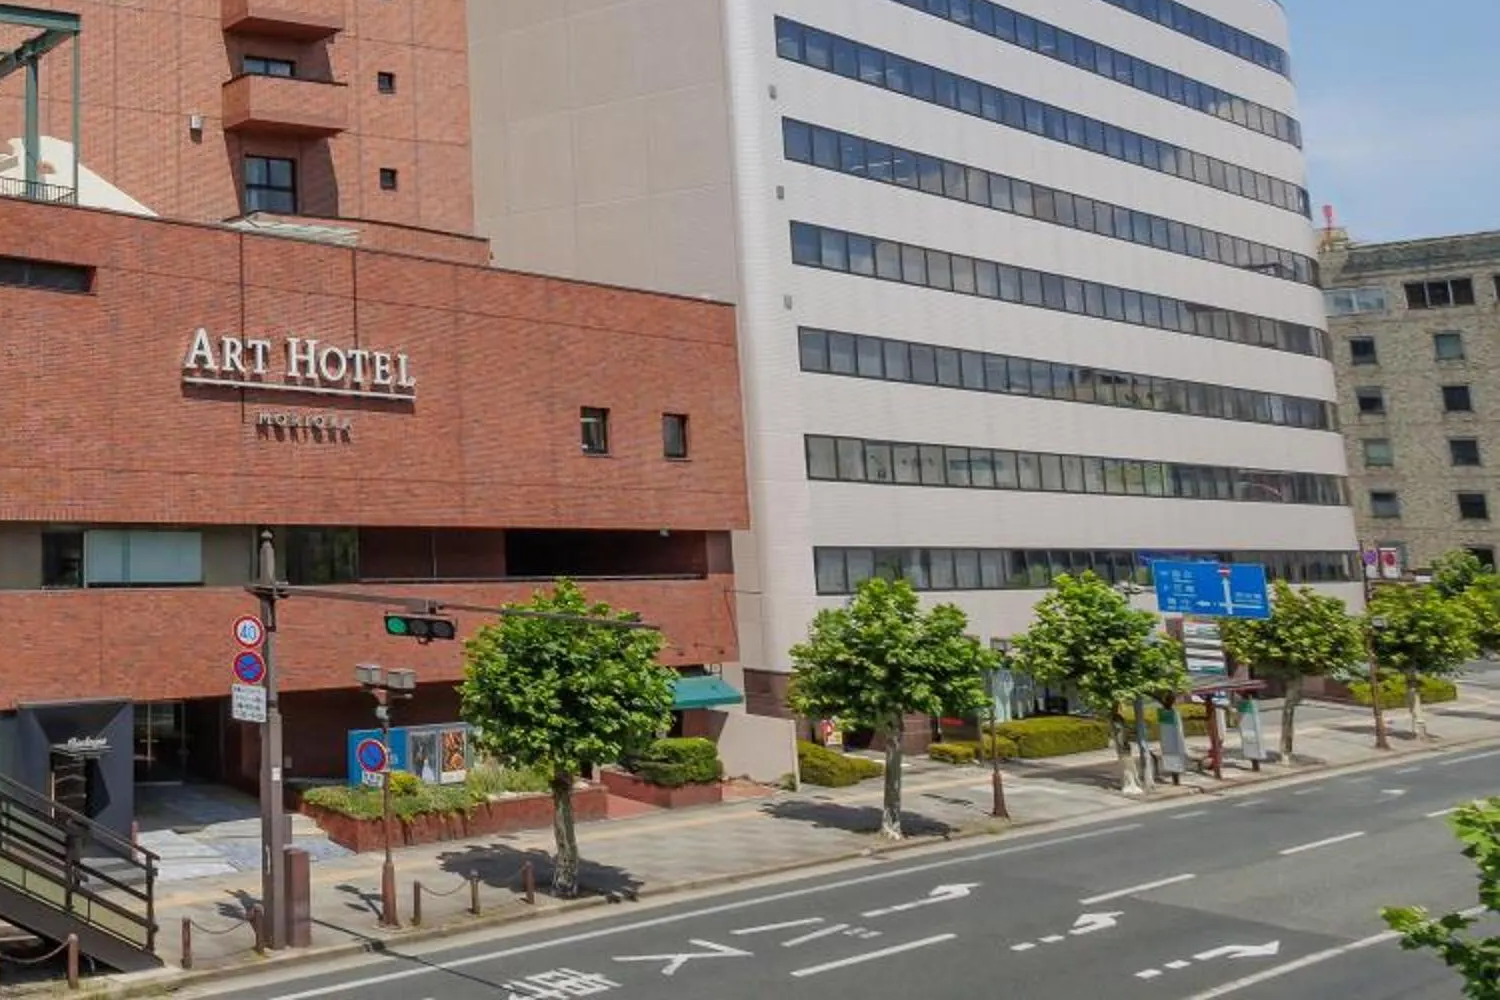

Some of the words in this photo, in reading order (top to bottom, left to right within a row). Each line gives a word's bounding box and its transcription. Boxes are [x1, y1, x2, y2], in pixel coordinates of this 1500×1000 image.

[185, 327, 270, 374] ART
[286, 337, 416, 387] HOTEL
[240, 623, 257, 641] 40
